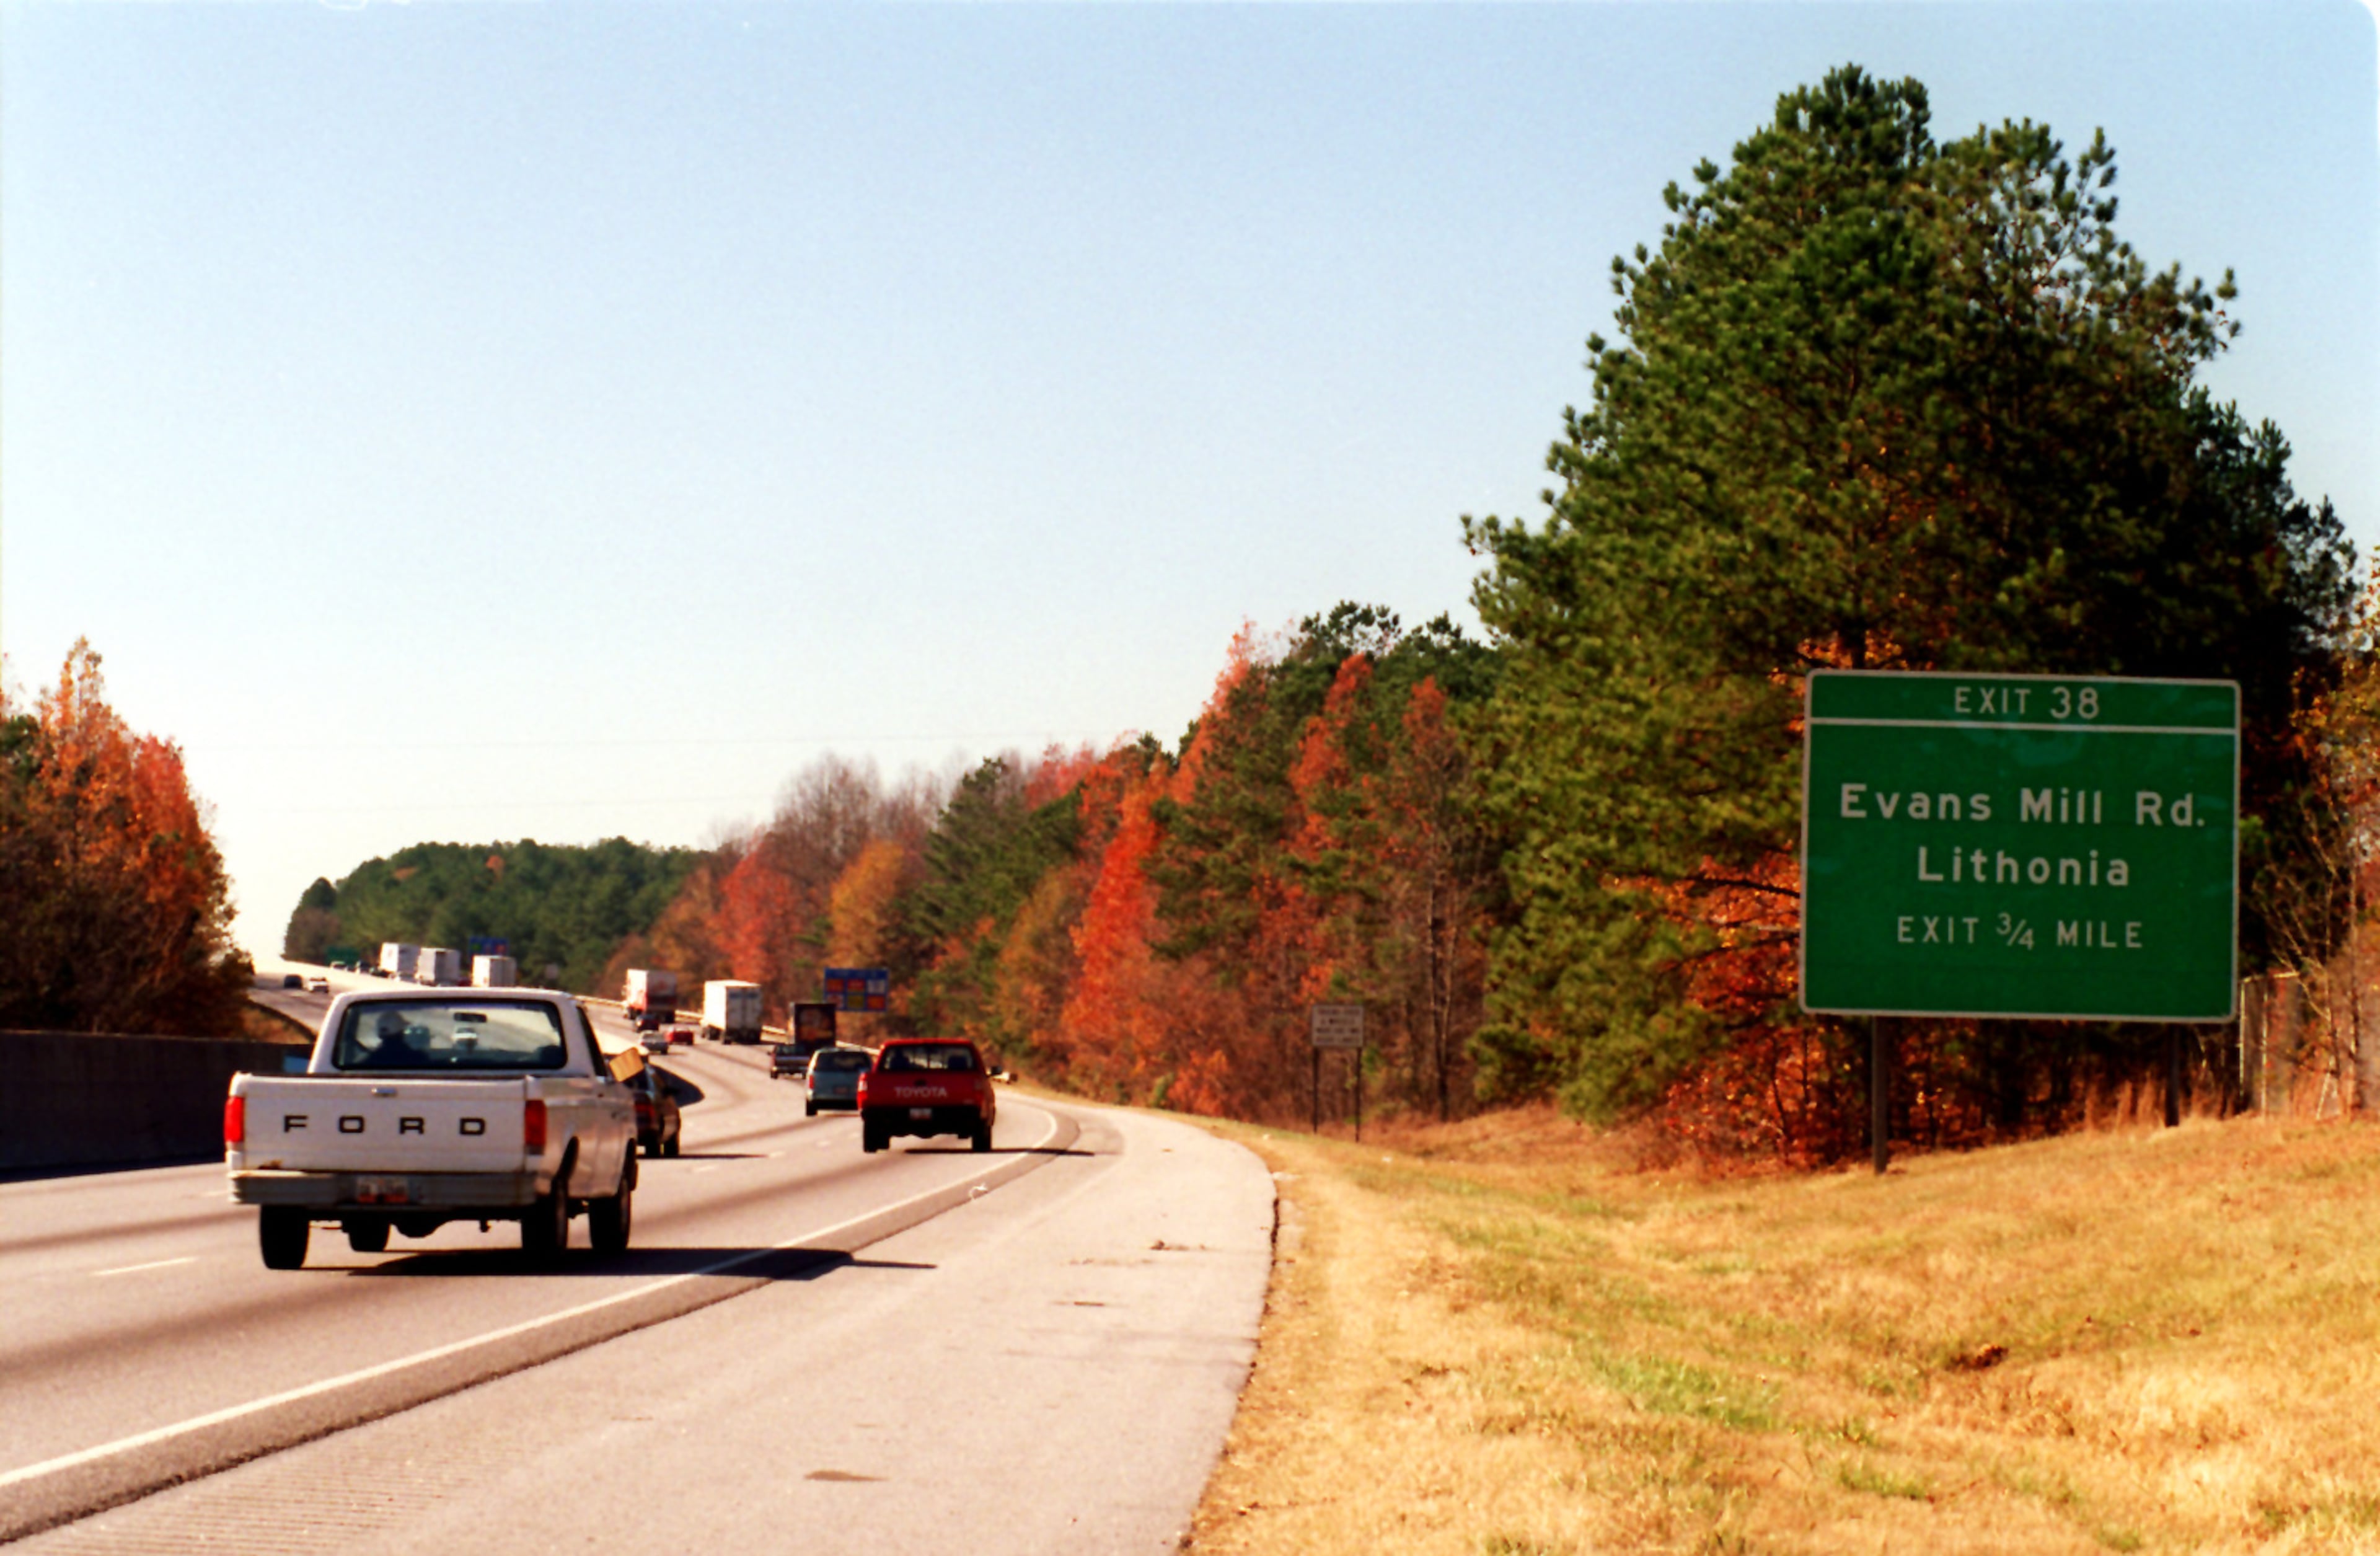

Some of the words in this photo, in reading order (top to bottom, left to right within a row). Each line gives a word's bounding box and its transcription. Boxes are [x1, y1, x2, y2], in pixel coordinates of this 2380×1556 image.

[1955, 687, 2031, 714] EXIT
[2050, 686, 2099, 719] 38
[1841, 783, 1992, 821] Evans
[2021, 787, 2102, 824] Mill
[2136, 791, 2205, 826] Rd.
[1918, 846, 2130, 886] Lithonia
[1897, 916, 1979, 944] EXIT
[2056, 921, 2143, 948] MILE
[894, 1086, 948, 1098] TOYOTA
[283, 1114, 487, 1137] FORD
